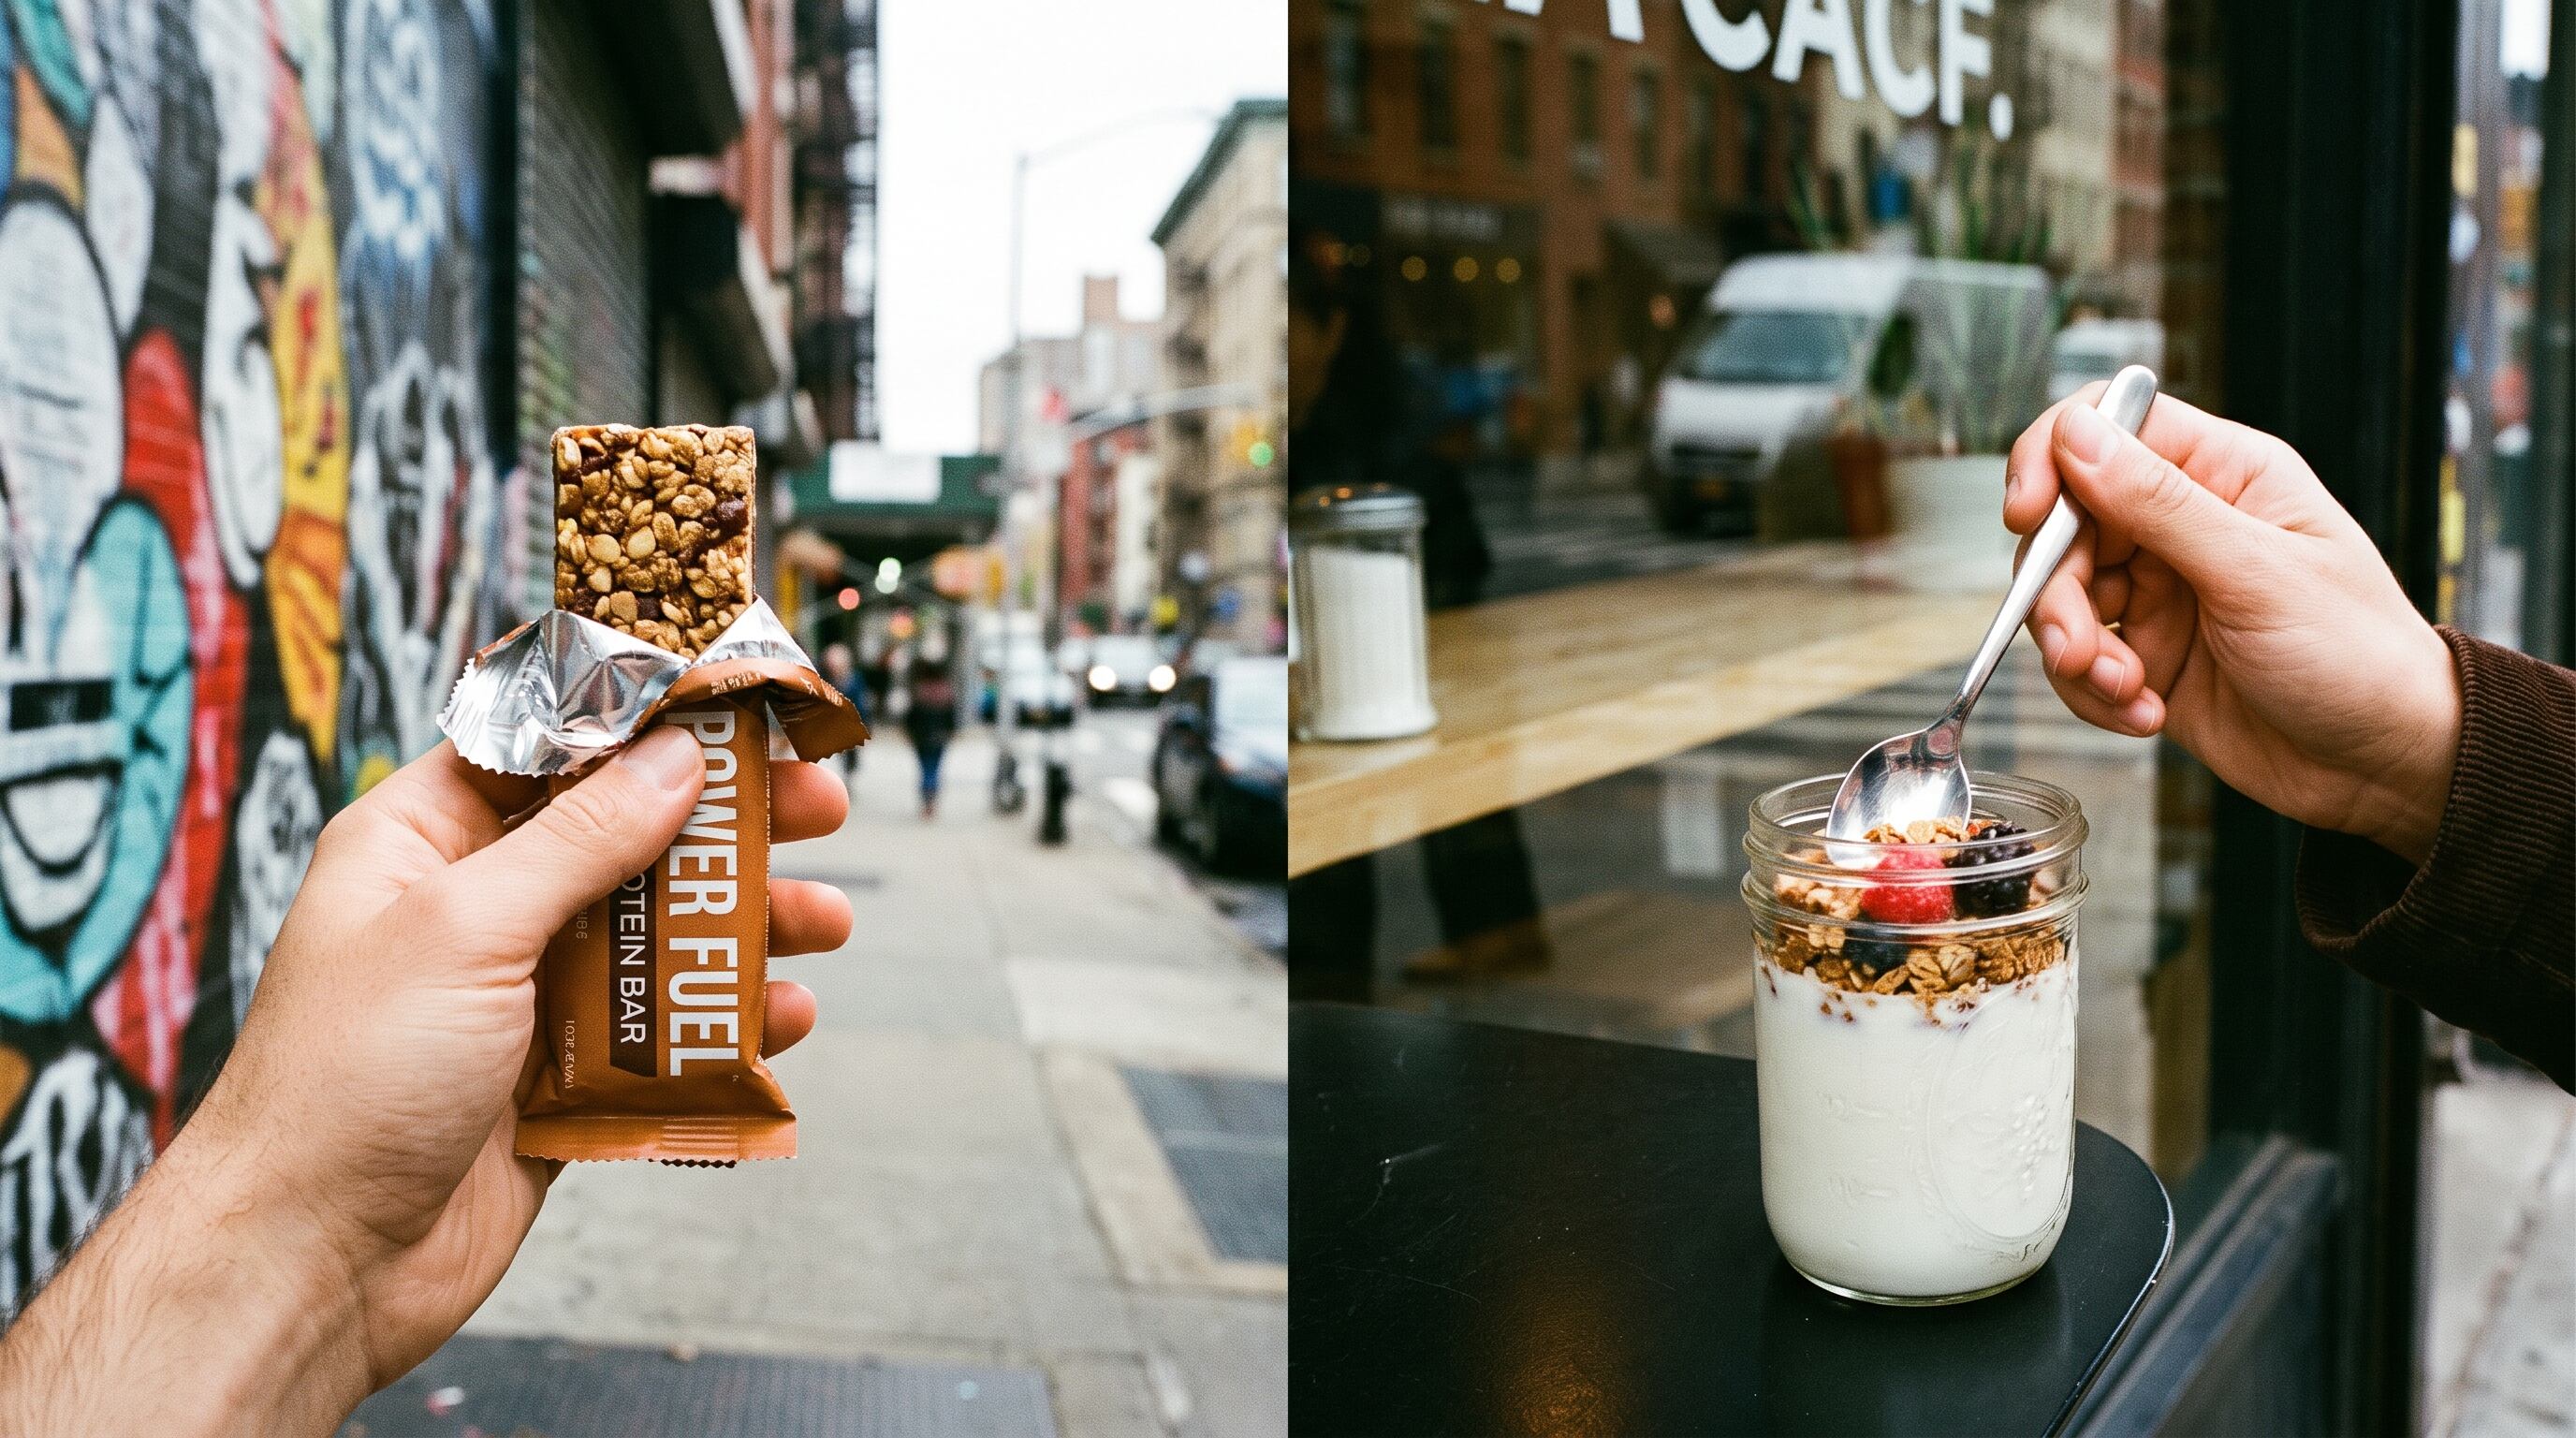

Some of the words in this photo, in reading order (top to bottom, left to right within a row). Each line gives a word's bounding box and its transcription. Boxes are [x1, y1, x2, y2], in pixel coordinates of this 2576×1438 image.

[620, 873, 646, 965] OTEIN
[620, 976, 646, 1044] BAR
[668, 937, 739, 1077] FUEL
